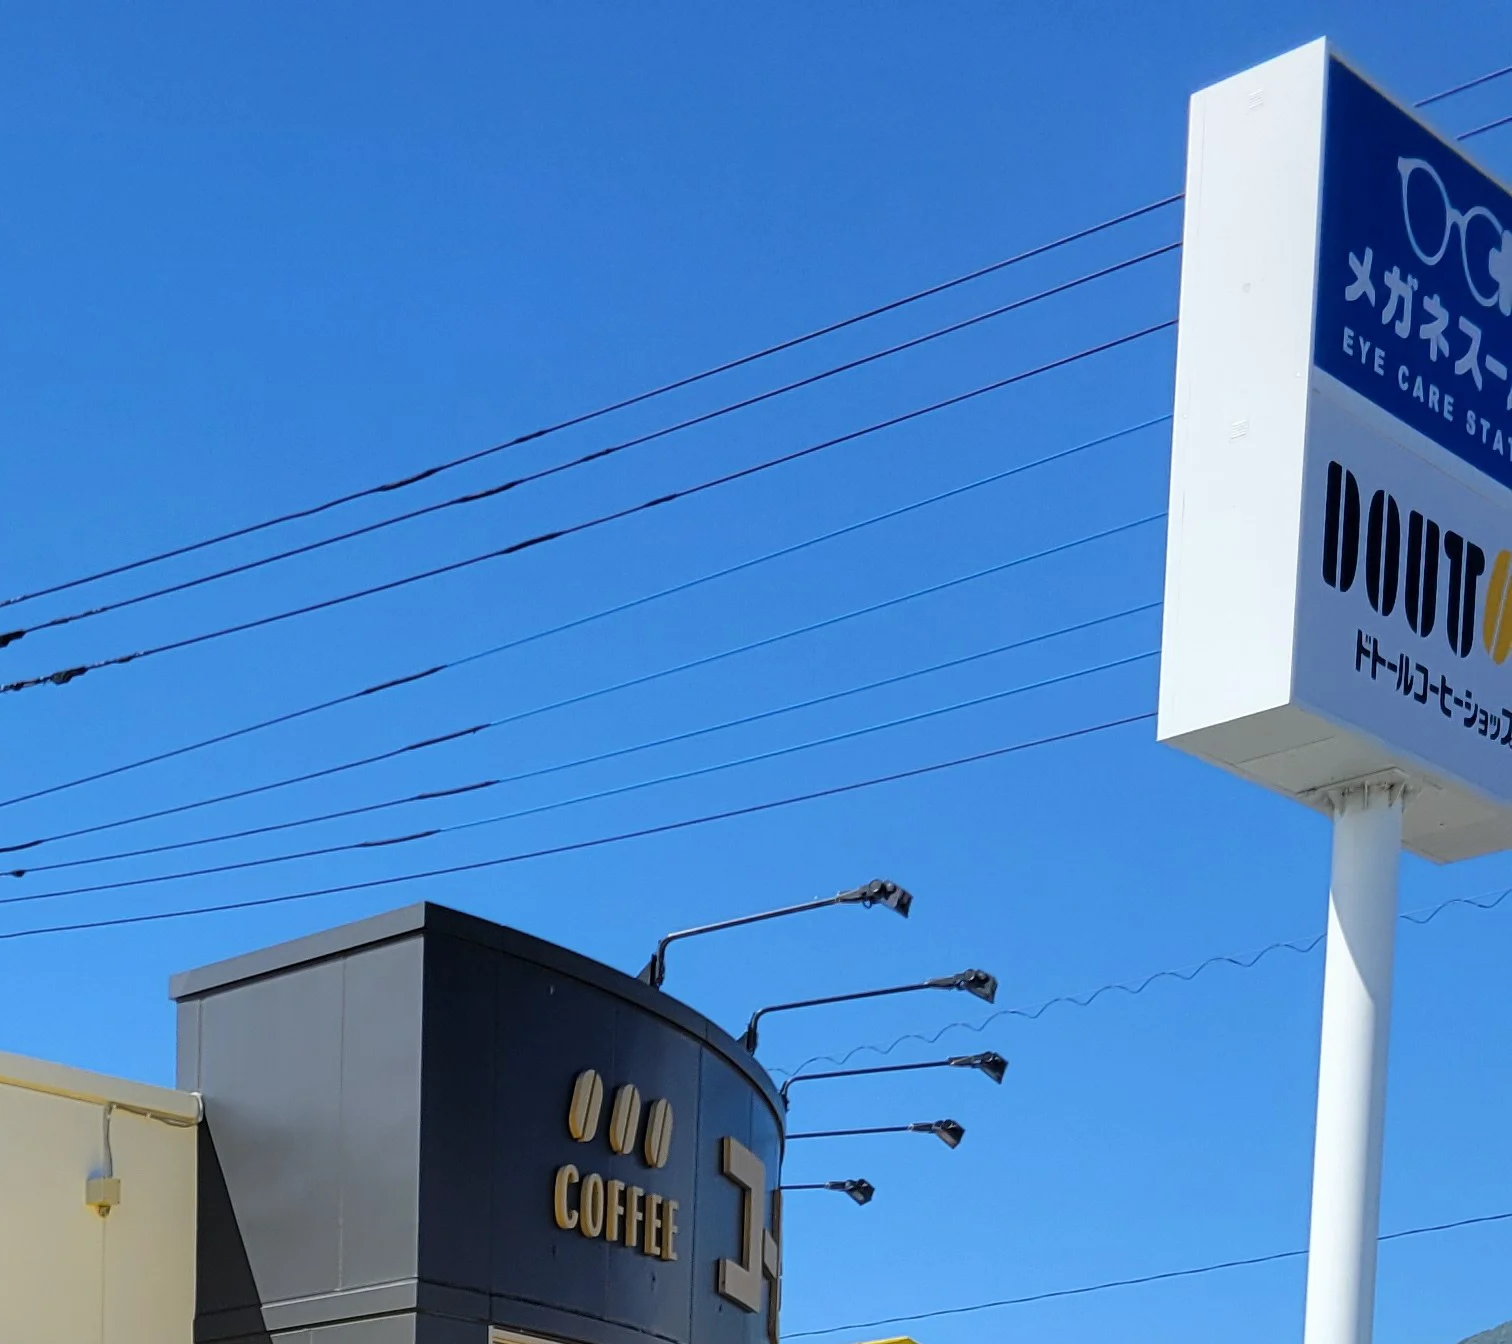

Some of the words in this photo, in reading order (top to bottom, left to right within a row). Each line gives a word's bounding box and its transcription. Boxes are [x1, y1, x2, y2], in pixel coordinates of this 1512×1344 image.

[1342, 325, 1386, 377] EYE
[1398, 364, 1454, 422] CARE
[1344, 246, 1512, 412] メガネスー
[554, 1163, 679, 1261] COFFEE
